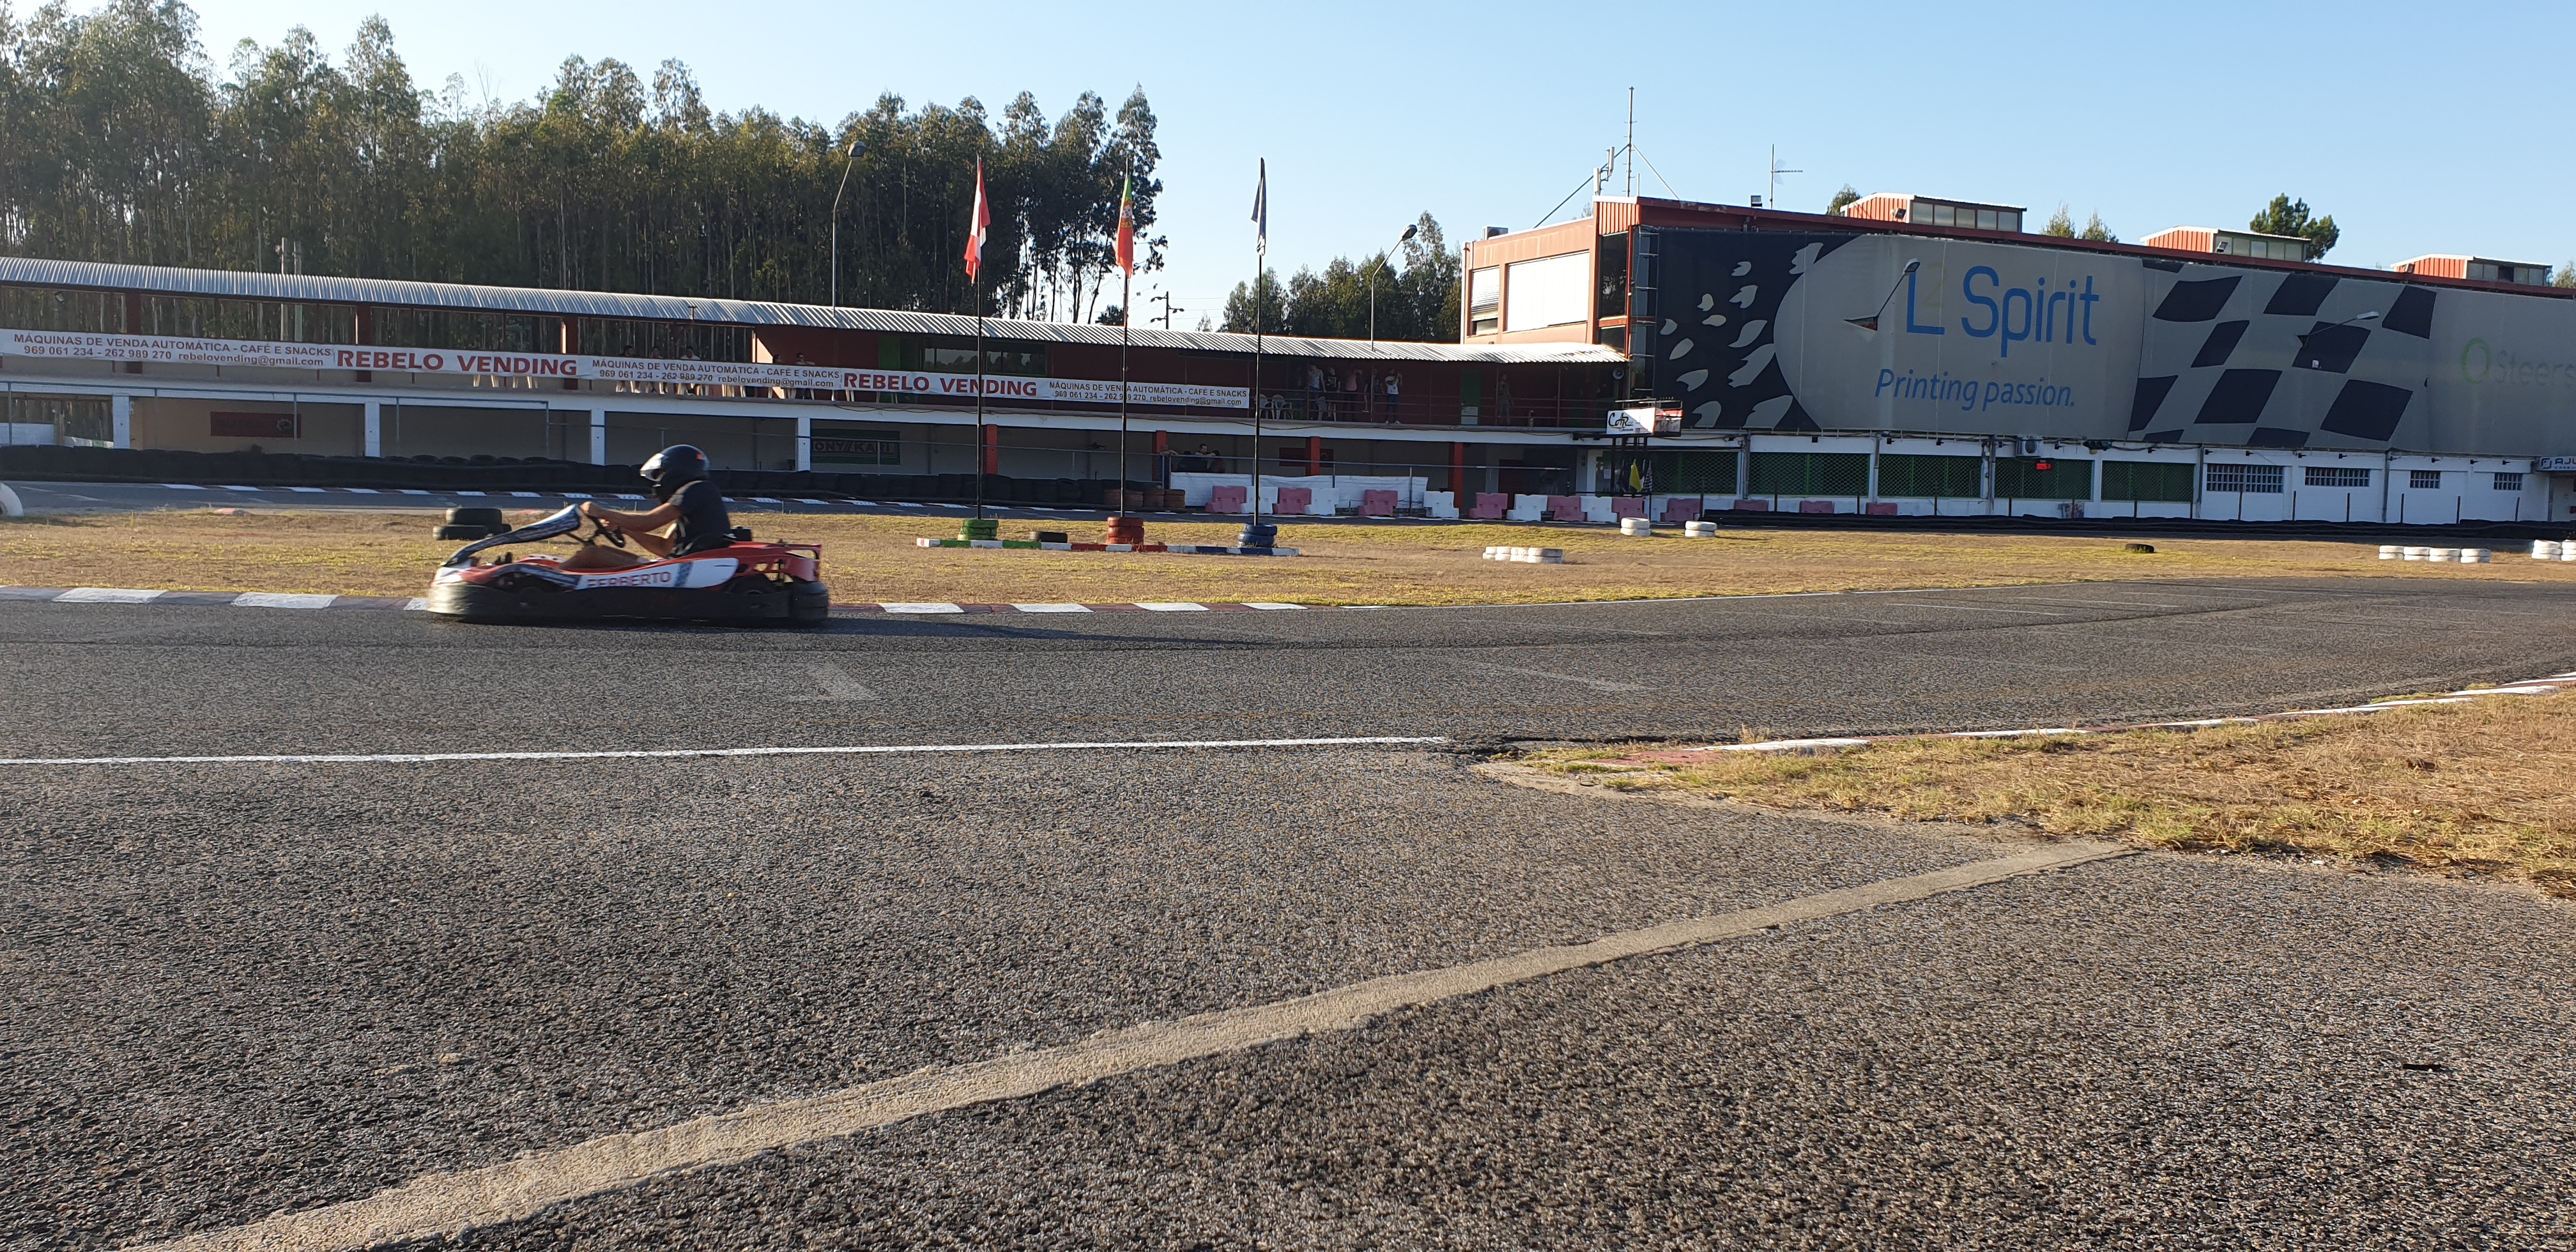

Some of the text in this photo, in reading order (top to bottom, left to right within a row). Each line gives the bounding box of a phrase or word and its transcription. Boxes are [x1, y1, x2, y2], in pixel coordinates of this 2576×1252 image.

[1961, 266, 2099, 358] Spirit
[14, 333, 82, 345] MÁQUINAS
[87, 337, 103, 346] DE
[107, 338, 149, 347] VENDA
[151, 340, 231, 351] AUTOMÁTICA
[240, 343, 270, 353] CAFÉ
[285, 347, 331, 356] SNACKS
[24, 346, 45, 355] 969
[49, 346, 68, 355] 061
[73, 347, 93, 356] 234
[105, 349, 125, 357] 262
[129, 349, 148, 358] 989
[153, 351, 171, 359] 270
[179, 353, 323, 365] rebelovending@gmail.com
[337, 350, 578, 375] REBELO VENDING
[592, 359, 644, 370] MÁQUINAS
[664, 363, 695, 372] VENDA
[698, 365, 759, 375] AUTOMÁTICA
[767, 367, 791, 377] CAFÉ
[802, 370, 839, 379] SNACKS
[718, 376, 834, 387] rebelovending@gmail.com
[844, 373, 1037, 396] REBELO VENDING
[1050, 381, 1090, 390] MÁQUINAS
[1133, 385, 1183, 394] AUTOMÁTICA
[1875, 369, 2074, 411] Printing passion.
[1150, 395, 1241, 405] rebelovending@gmail.com
